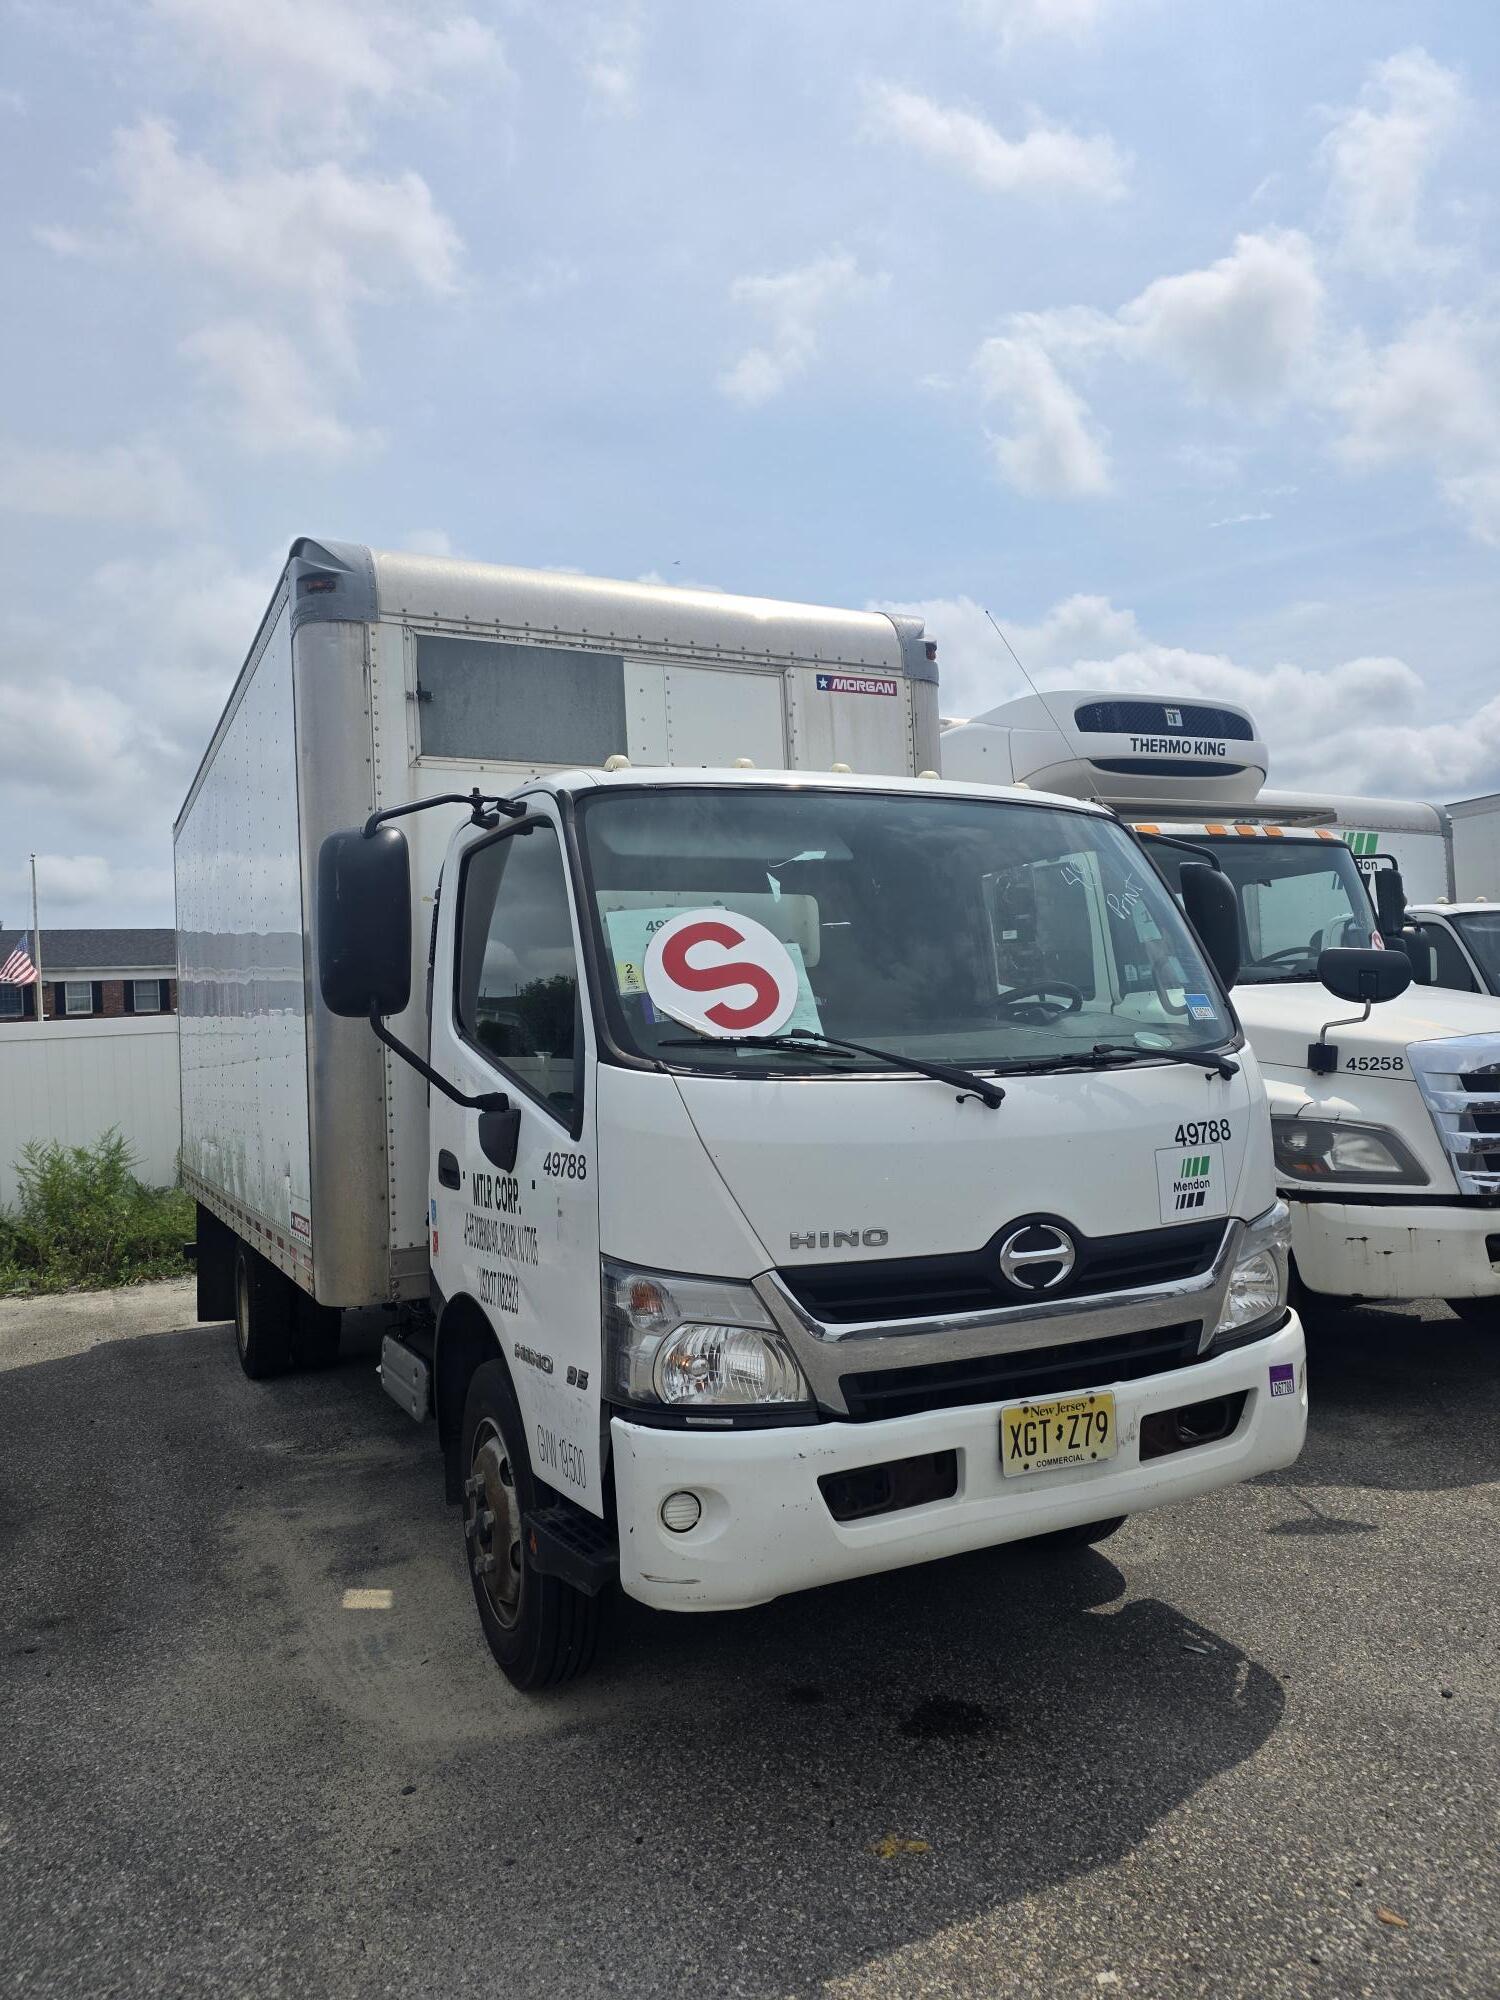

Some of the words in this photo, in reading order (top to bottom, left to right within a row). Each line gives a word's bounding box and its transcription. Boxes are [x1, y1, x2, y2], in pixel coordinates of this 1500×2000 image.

[832, 678, 895, 694] MORGAN
[1130, 738, 1191, 754] THERMO
[1195, 741, 1226, 756] KING
[662, 921, 780, 1030] S
[1346, 1056, 1404, 1071] 45258
[1175, 1119, 1232, 1147] 49788
[543, 1152, 586, 1180] 49788
[472, 1172, 493, 1209] MTLR
[495, 1175, 522, 1215] CORP.
[1173, 1178, 1211, 1193] Mendon
[790, 1227, 889, 1249] HINO
[1030, 1405, 1055, 1418] New
[1056, 1402, 1087, 1416] Jersey
[1010, 1419, 1051, 1460] XGT
[1067, 1411, 1108, 1450] Z79
[1036, 1454, 1085, 1468] COMMERCIAL
